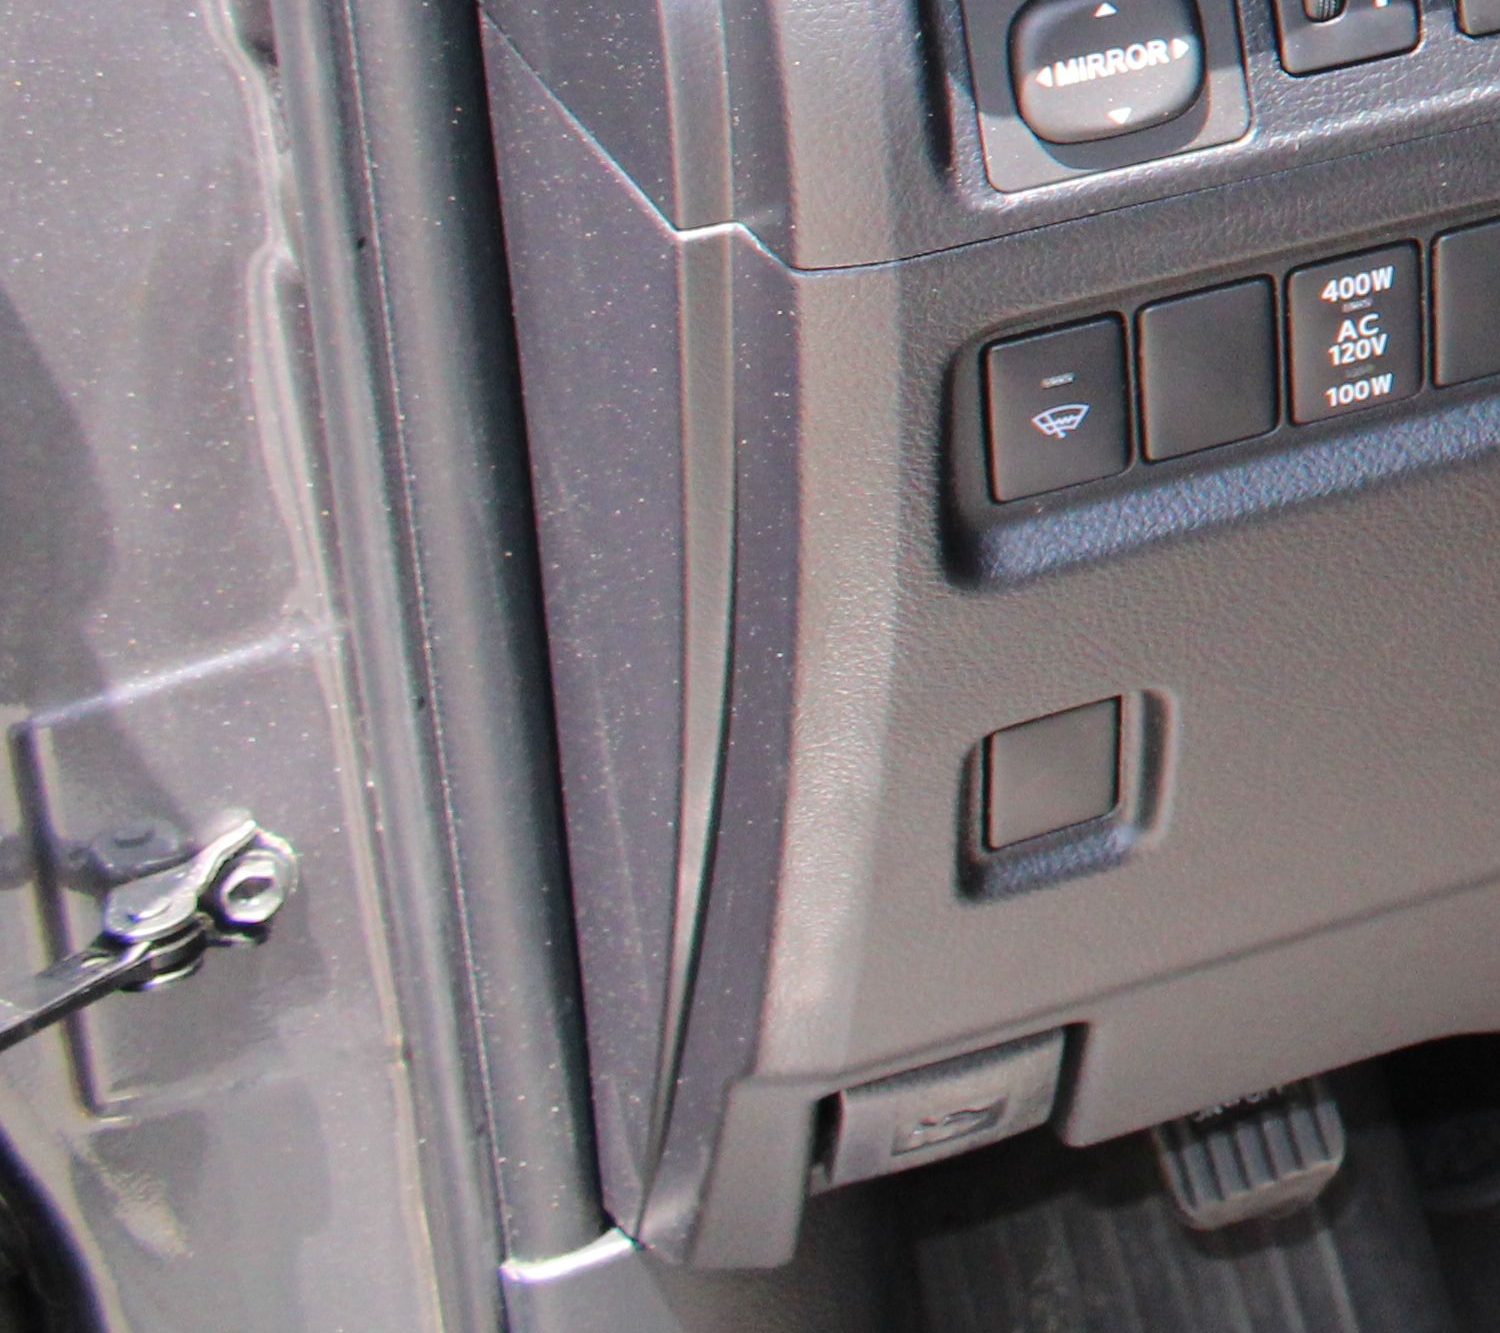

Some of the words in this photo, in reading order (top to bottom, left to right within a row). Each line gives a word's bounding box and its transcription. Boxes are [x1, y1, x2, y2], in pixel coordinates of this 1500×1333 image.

[1054, 39, 1170, 87] MIRROR
[1321, 265, 1395, 302] 400W
[1337, 313, 1381, 343] AC
[1328, 333, 1389, 366] 120V
[1325, 373, 1395, 407] 100W
